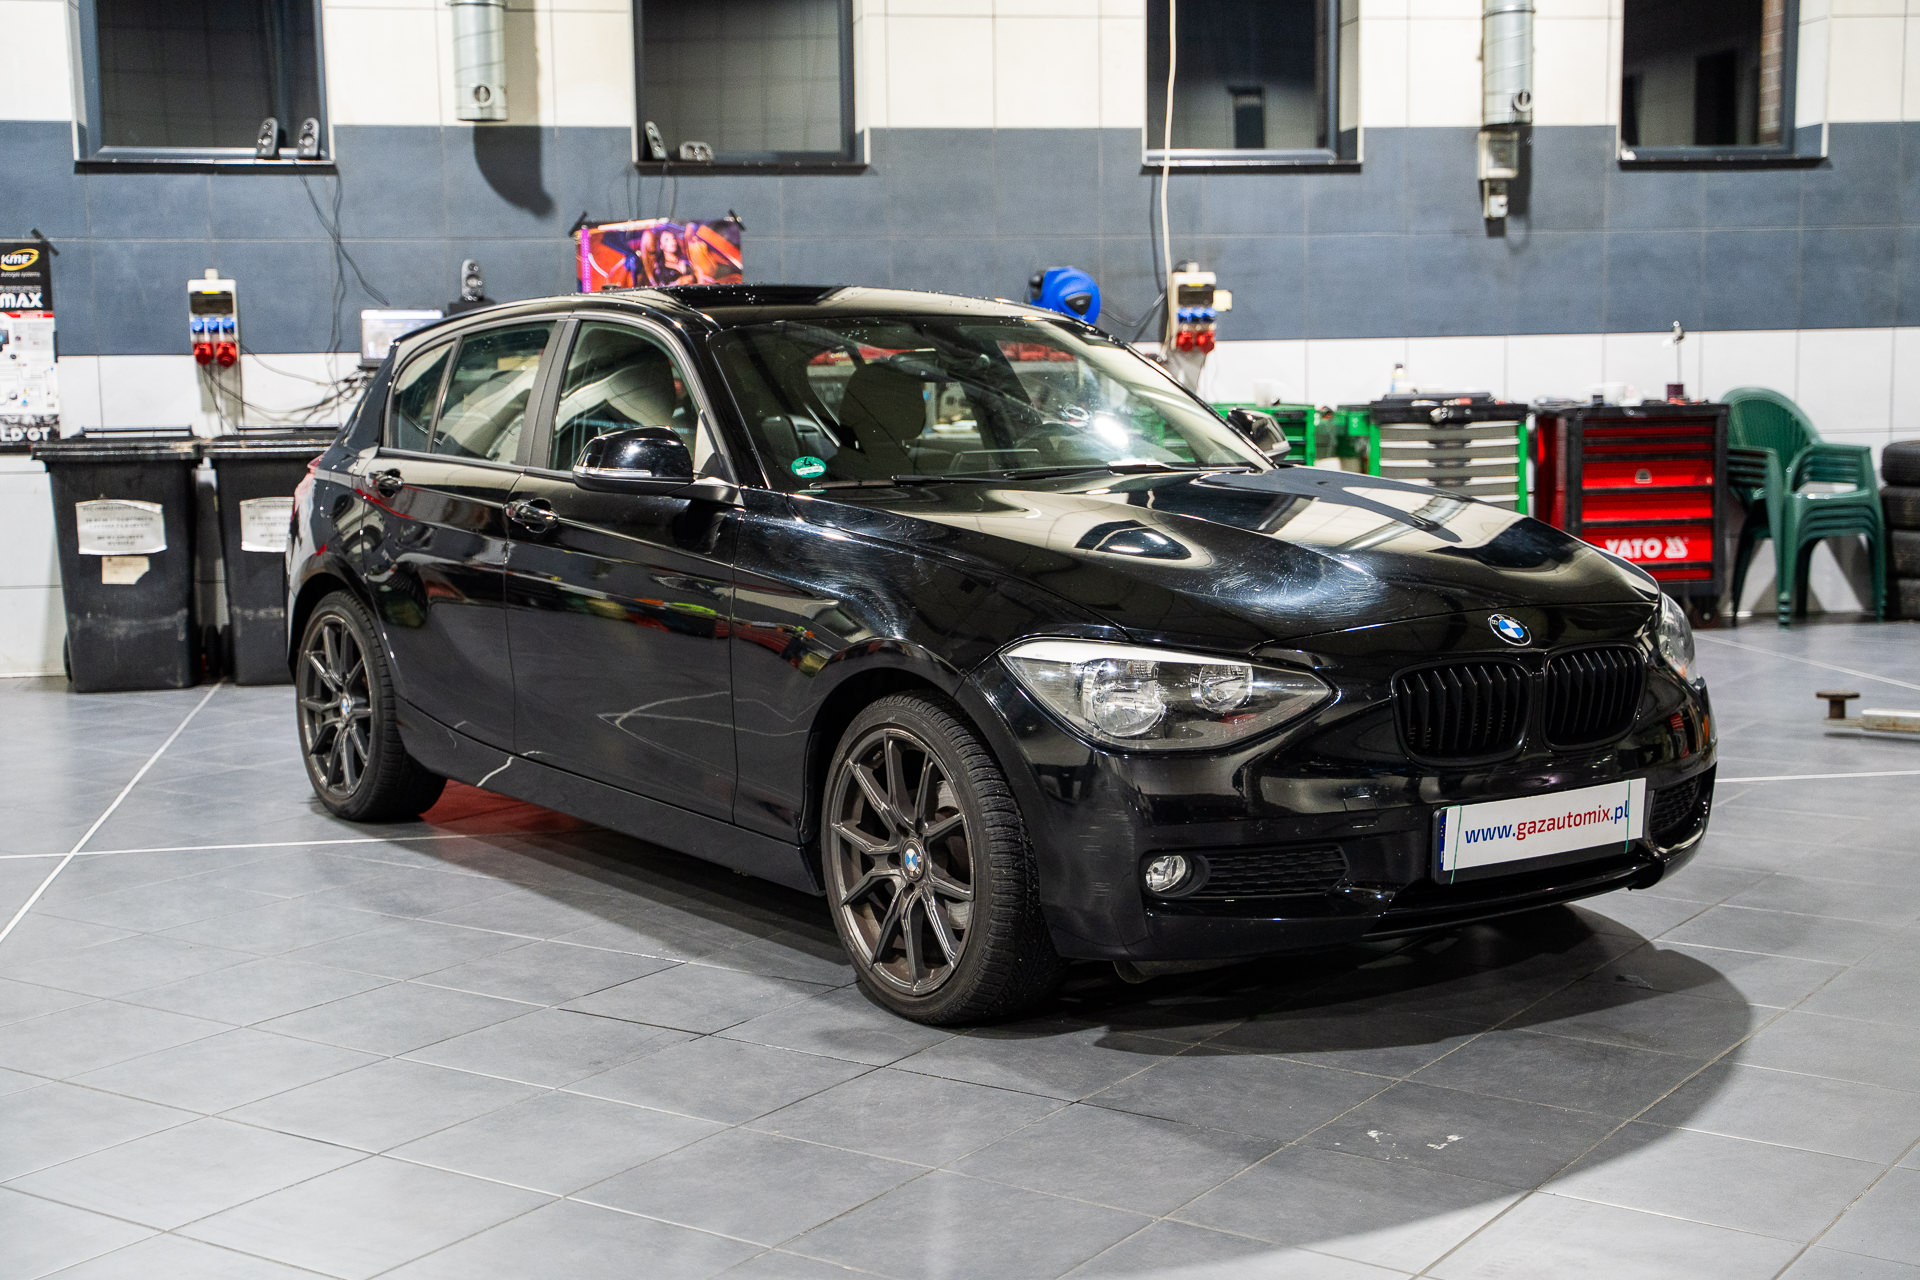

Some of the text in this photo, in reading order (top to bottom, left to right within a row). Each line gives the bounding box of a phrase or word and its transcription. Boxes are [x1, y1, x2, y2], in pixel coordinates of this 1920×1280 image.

[1, 254, 30, 265] KME
[1605, 537, 1663, 559] YATO
[1465, 800, 1630, 844] www.gazautomix.pl
